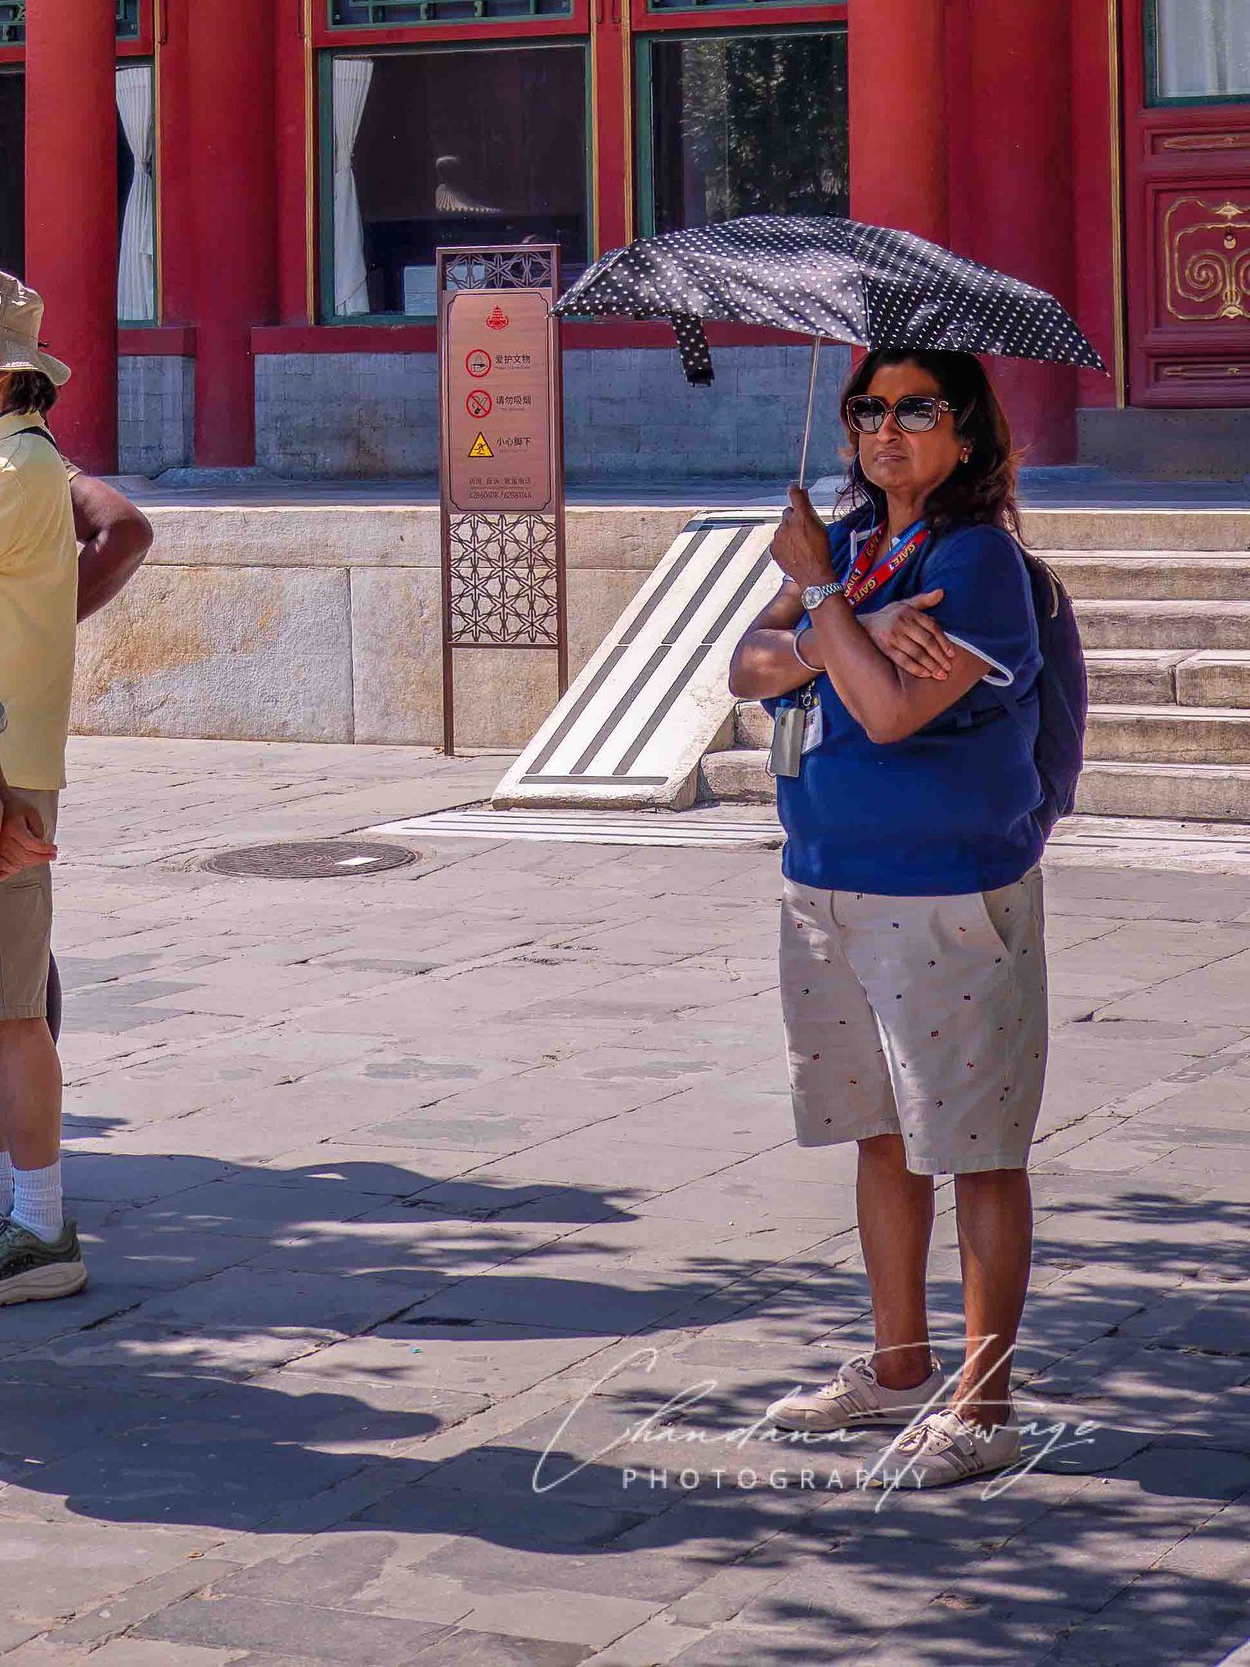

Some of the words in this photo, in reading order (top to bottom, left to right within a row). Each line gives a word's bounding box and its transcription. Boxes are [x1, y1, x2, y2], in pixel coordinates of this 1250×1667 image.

[494, 354, 531, 364] 爱护文物
[496, 395, 532, 405] 请勿吸烟
[496, 436, 532, 447] 小心脚下
